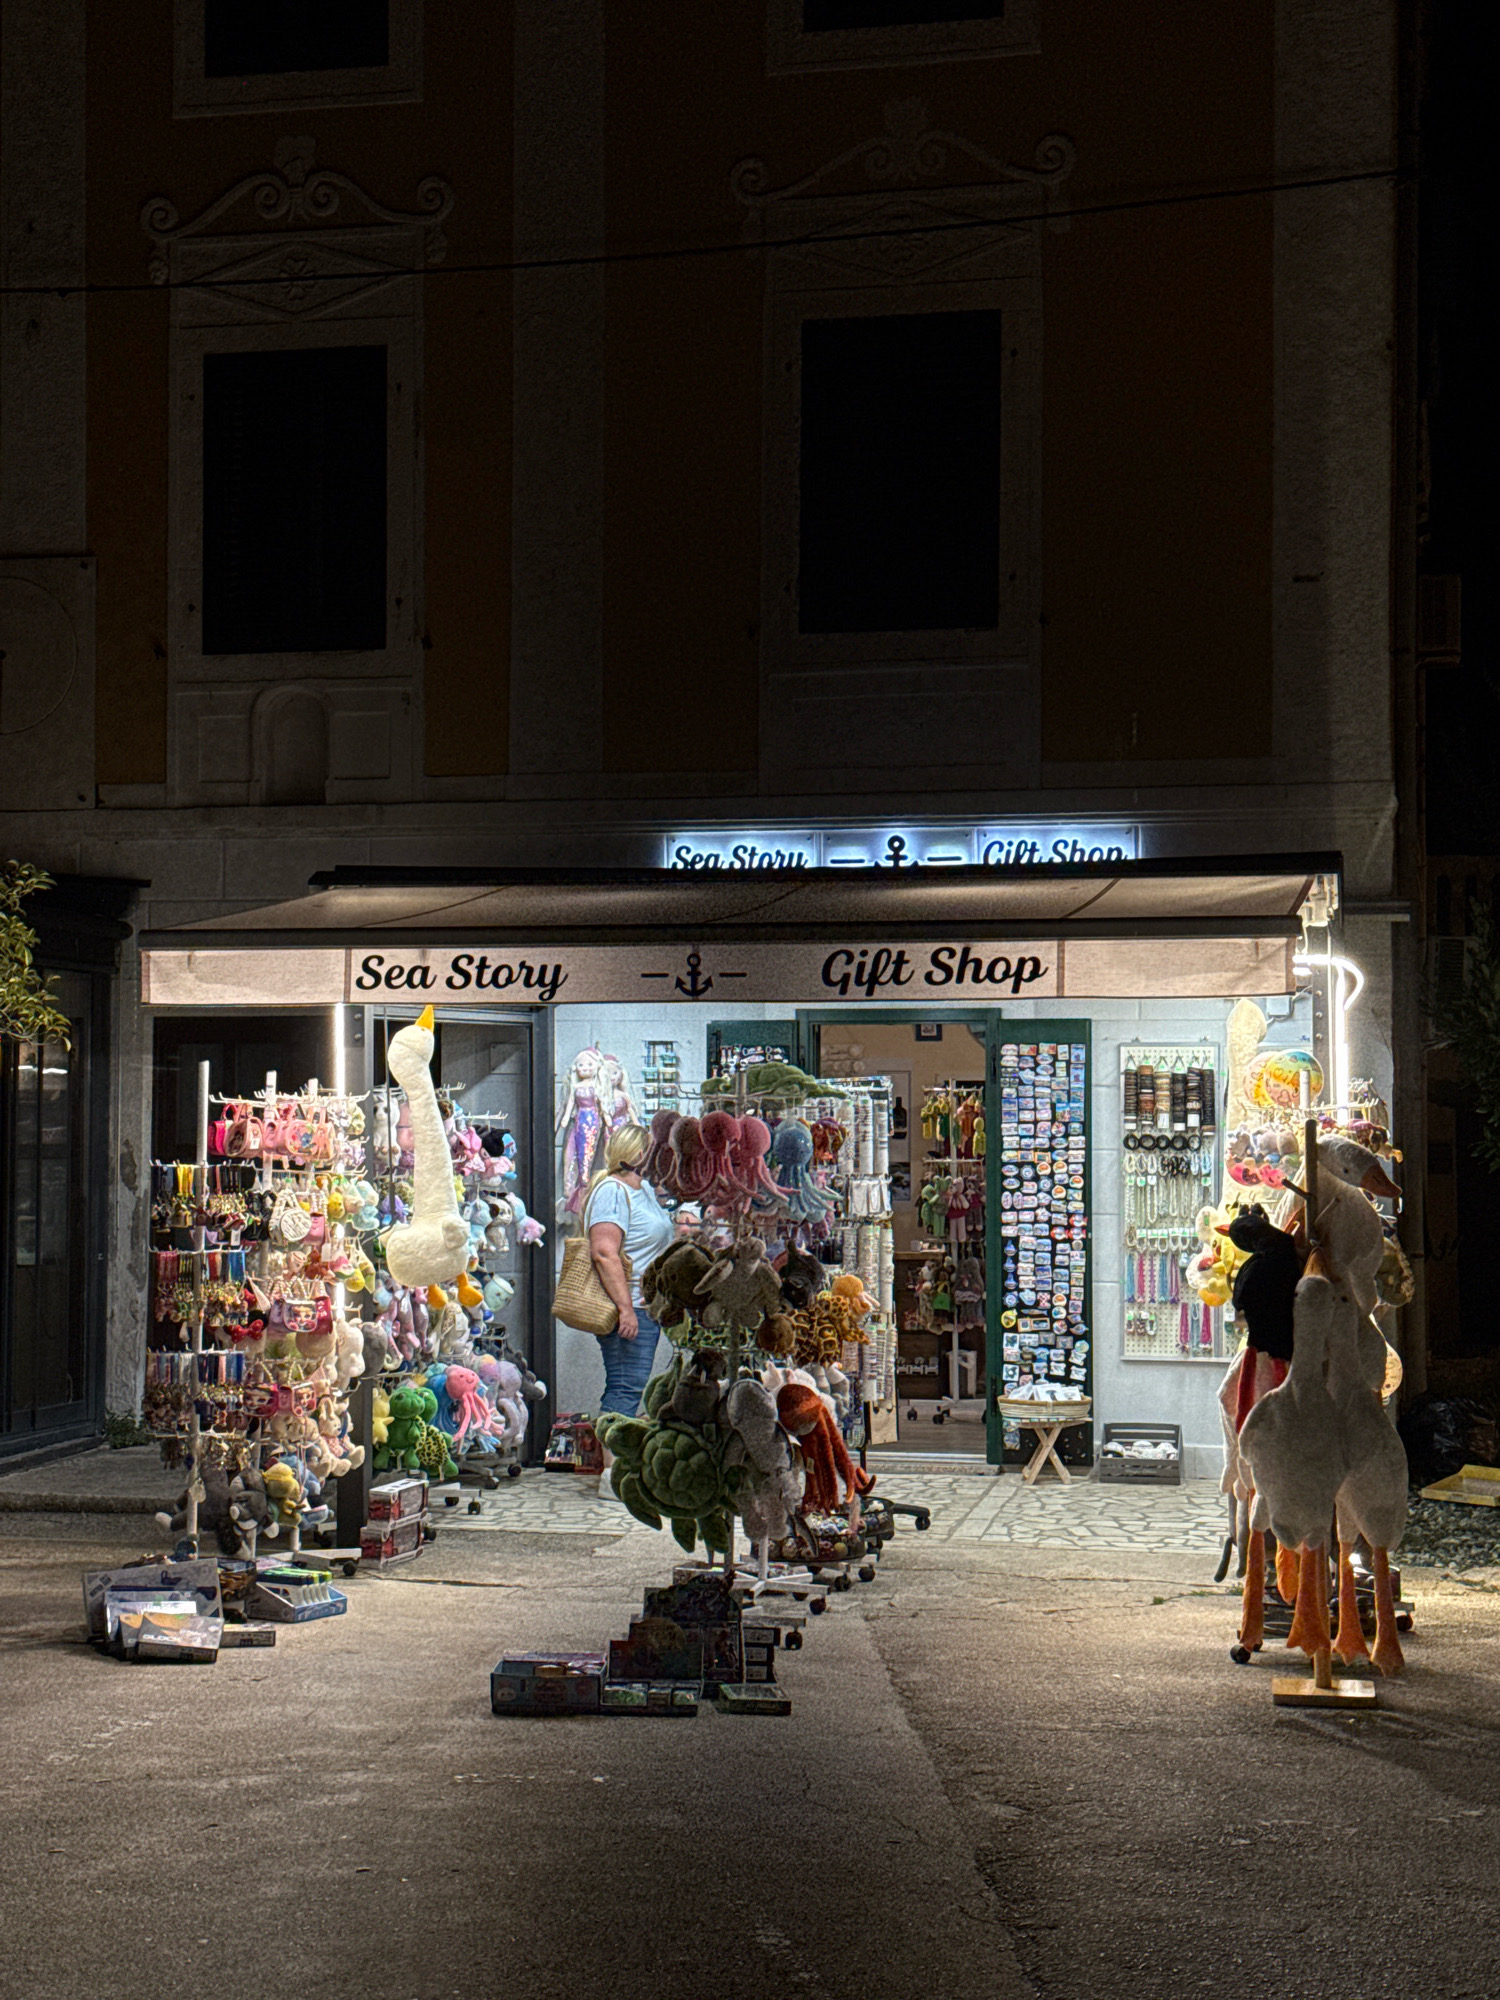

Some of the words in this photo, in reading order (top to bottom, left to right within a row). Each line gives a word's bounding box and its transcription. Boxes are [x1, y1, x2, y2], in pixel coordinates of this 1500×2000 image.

[671, 845, 724, 868] Sea
[356, 955, 437, 990] Sea
[446, 954, 568, 1002] Story
[822, 949, 914, 997] Gift
[925, 947, 1047, 994] Shop
